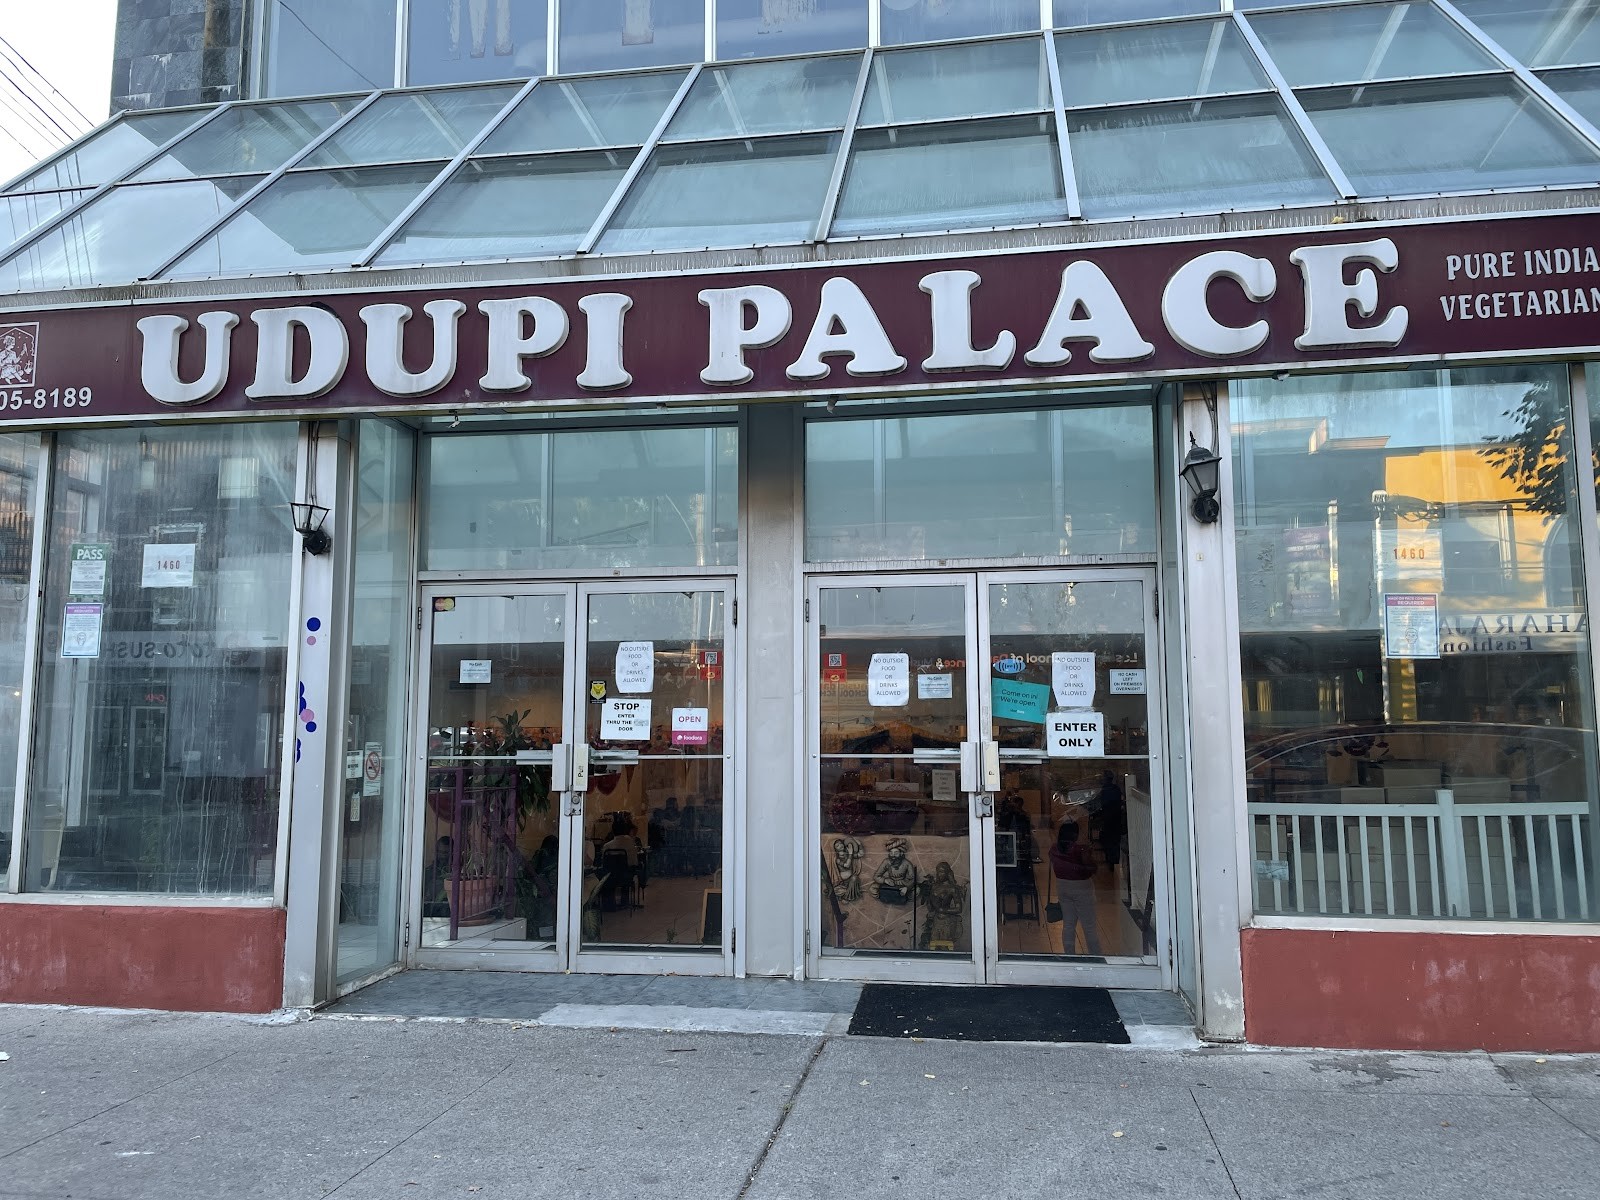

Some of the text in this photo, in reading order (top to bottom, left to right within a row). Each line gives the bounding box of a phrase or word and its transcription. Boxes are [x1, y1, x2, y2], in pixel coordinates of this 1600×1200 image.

[1446, 251, 1516, 281] PURE
[136, 236, 1409, 407] UDUPI PALACE
[77, 549, 104, 560] PASS
[1393, 548, 1425, 560] 1460
[157, 560, 181, 570] 1460
[1001, 689, 1021, 697] Come
[1000, 695, 1018, 703] We're
[1054, 722, 1098, 732] ENTER
[1058, 738, 1094, 748] ONLY
